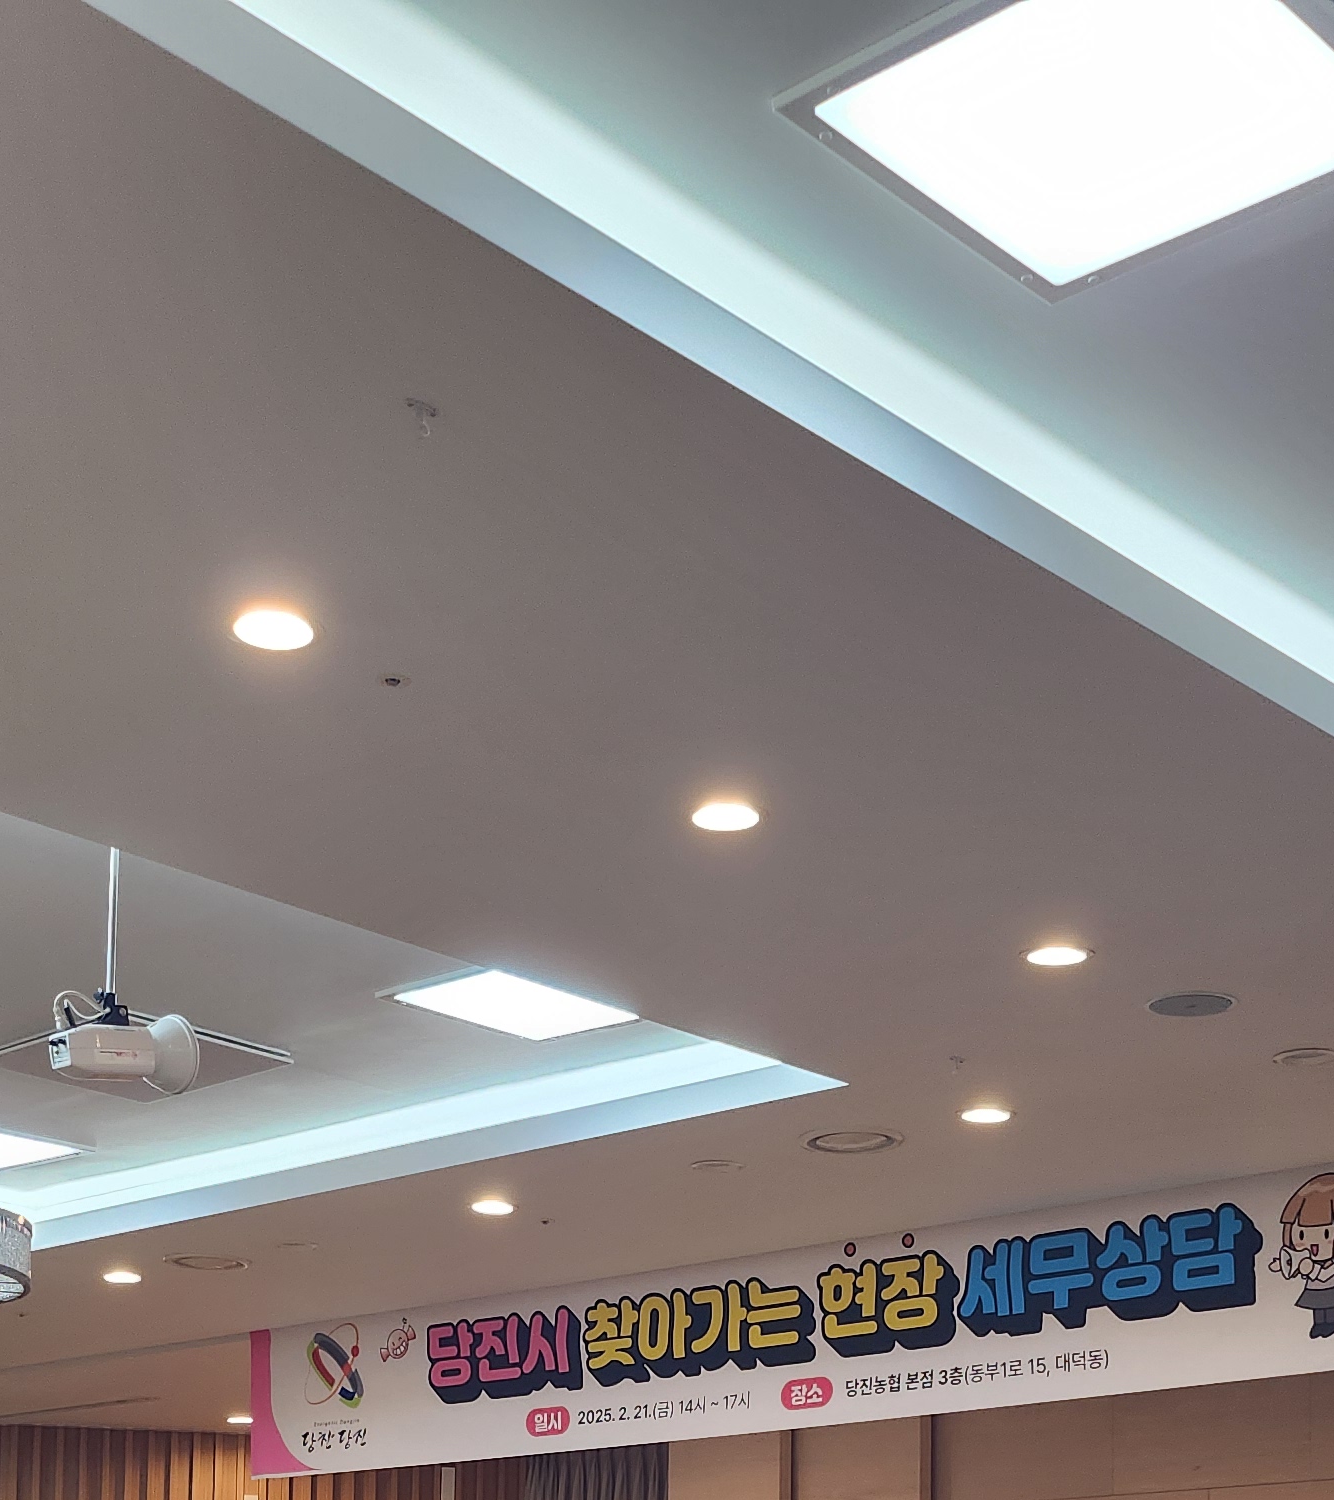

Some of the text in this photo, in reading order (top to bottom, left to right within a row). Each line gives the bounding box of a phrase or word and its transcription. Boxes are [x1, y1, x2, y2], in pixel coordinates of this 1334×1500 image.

[427, 1203, 1260, 1402] 당진시 찾아가는 현장 세무상담
[789, 1349, 1110, 1405] 장소 당진농협 본점 3층(동부1로 15, 대덕동)
[533, 1411, 563, 1433] 일시
[577, 1407, 616, 1426] 2025.
[618, 1405, 631, 1422] 2.
[633, 1400, 675, 1422] 21.(금)
[678, 1394, 707, 1415] 14시
[724, 1390, 751, 1410] 17시
[337, 1427, 367, 1450] 당진
